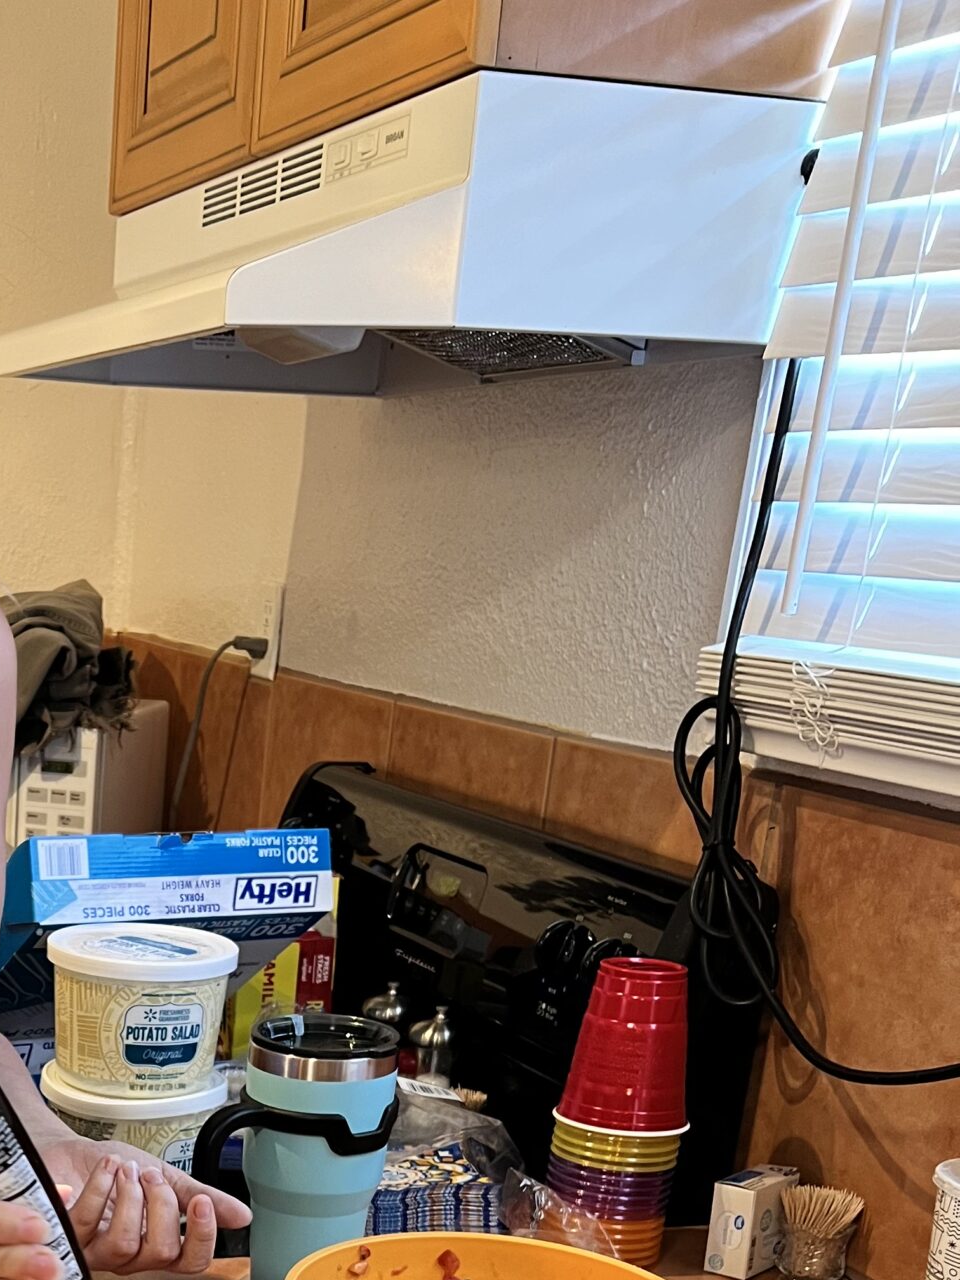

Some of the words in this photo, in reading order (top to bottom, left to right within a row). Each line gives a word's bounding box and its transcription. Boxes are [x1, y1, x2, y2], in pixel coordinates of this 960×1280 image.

[226, 838, 250, 847] FORKS
[250, 836, 280, 847] PLASTIC
[287, 835, 318, 845] PIECES
[258, 849, 282, 858] CLEAR
[287, 846, 319, 864] 300
[161, 880, 191, 891] WEIGHT
[192, 879, 221, 890] HEAVY
[240, 878, 312, 905] Hefty
[180, 893, 204, 902] FORKS
[83, 906, 125, 919] PIECES
[129, 904, 151, 917] 300
[165, 905, 196, 915] PLASTIC
[197, 903, 221, 913] CLEAR
[250, 924, 305, 937] 300
[261, 962, 276, 1008] AMIL
[126, 1026, 167, 1042] POTATO
[171, 1024, 201, 1040] SALAD
[142, 1049, 184, 1064] Original
